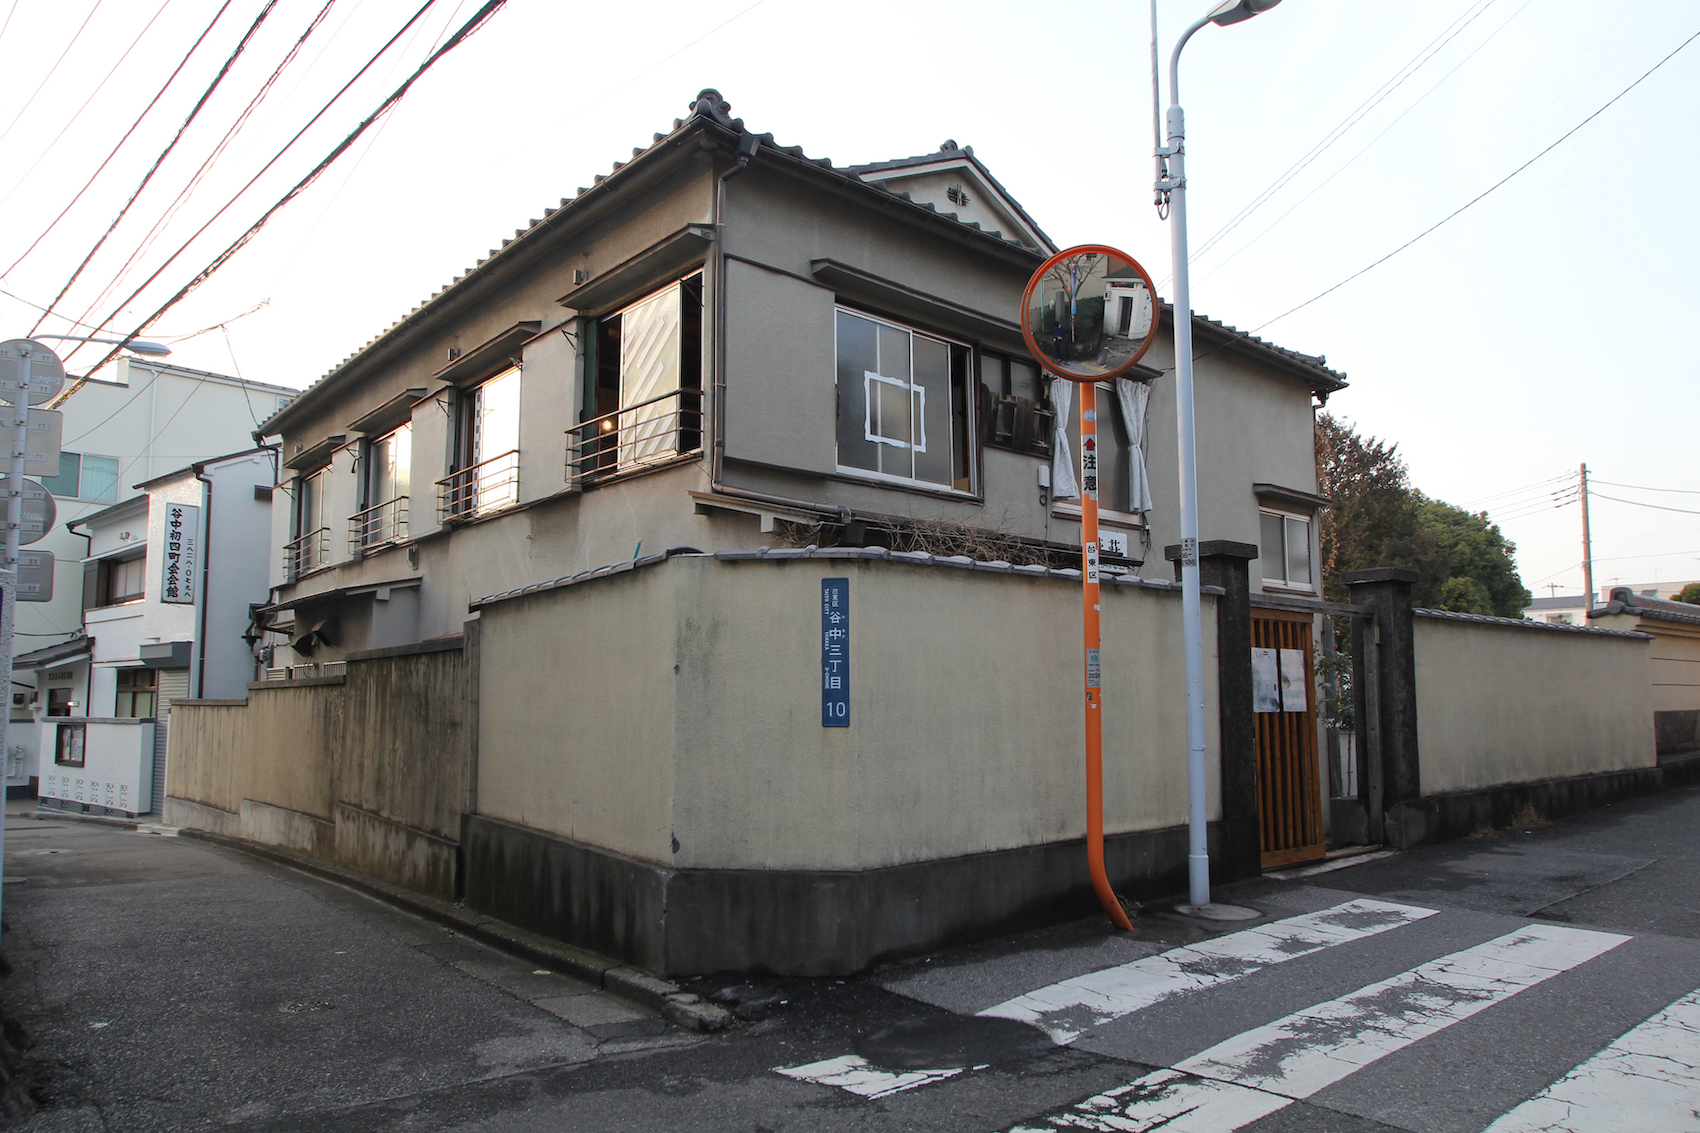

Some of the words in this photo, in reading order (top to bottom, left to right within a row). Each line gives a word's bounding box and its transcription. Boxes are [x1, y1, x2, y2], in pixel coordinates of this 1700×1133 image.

[1083, 454, 1097, 491] 注意
[165, 507, 183, 598] 谷中初四町会会館
[1087, 545, 1097, 580] 台東区
[829, 611, 842, 689] 谷中三丁目
[826, 702, 846, 717] 10
